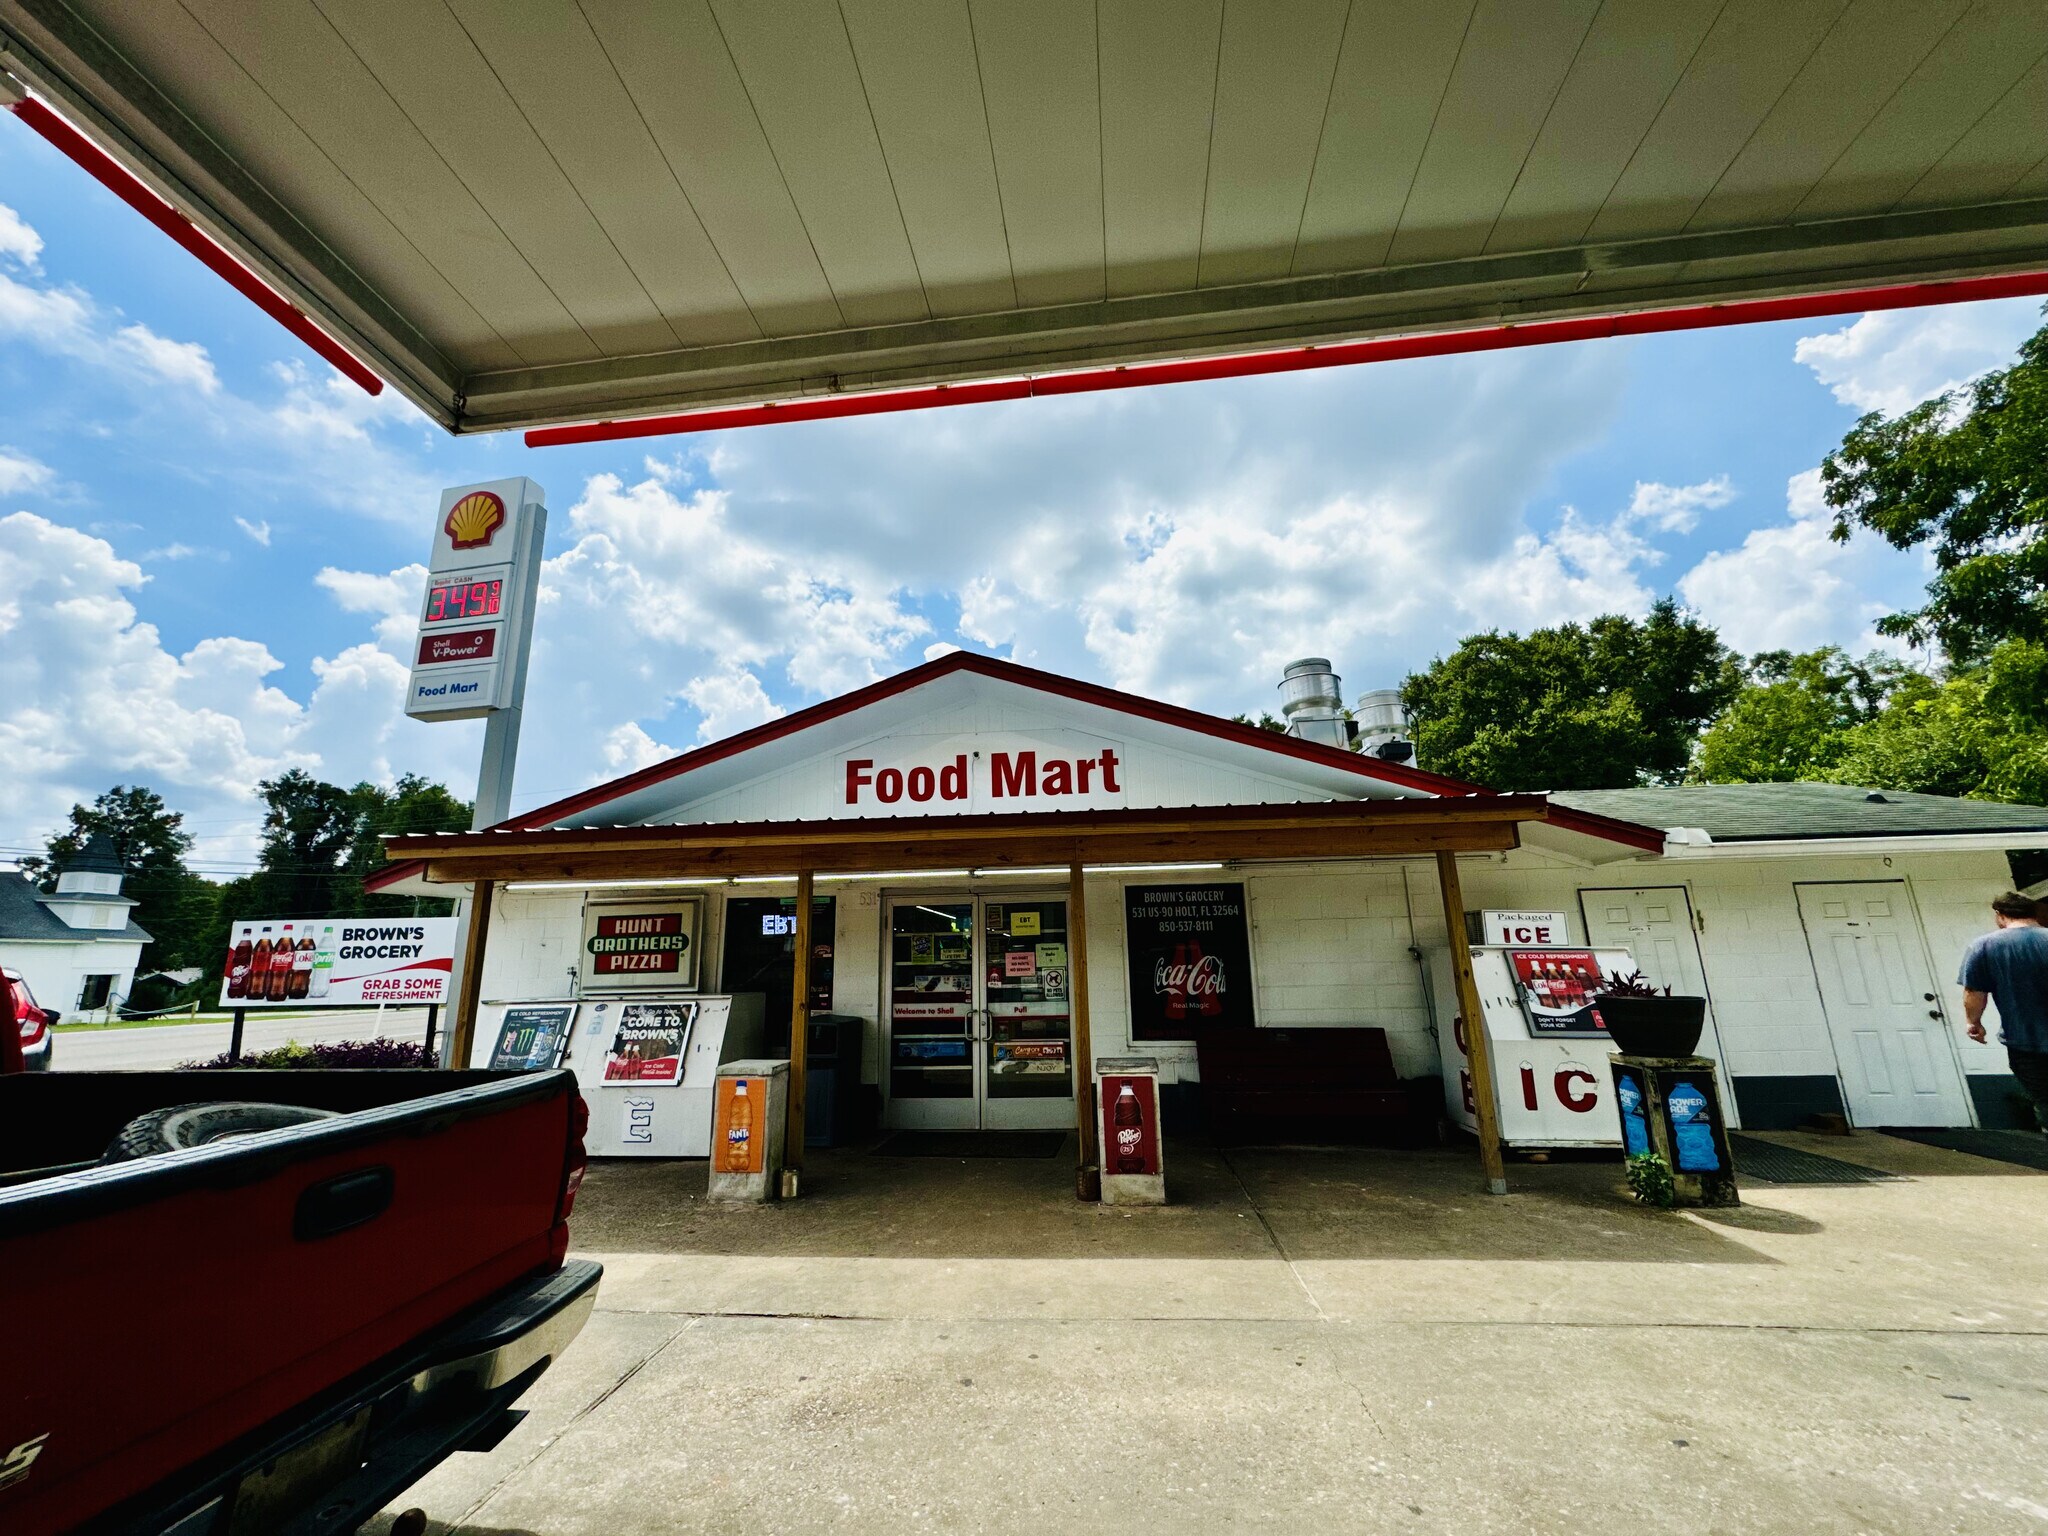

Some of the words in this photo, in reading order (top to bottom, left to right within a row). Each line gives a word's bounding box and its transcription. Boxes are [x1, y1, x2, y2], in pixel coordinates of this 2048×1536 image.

[454, 576, 473, 584] CASH
[433, 640, 450, 648] Shell
[433, 646, 478, 658] V-Power
[418, 684, 447, 697] Food
[449, 682, 478, 694] Mart
[846, 754, 968, 805] Food
[991, 749, 1121, 798] Mart
[1144, 892, 1184, 903] BROWN'S
[1185, 891, 1225, 902] GROCERY
[1132, 907, 1146, 918] 531
[1175, 906, 1199, 917] HOLT,
[1201, 906, 1211, 916] FL
[1213, 905, 1239, 916] 32564
[1497, 914, 1553, 922] Packaged
[615, 918, 665, 934] HUNT
[1159, 921, 1214, 932] 850-537-8111
[342, 927, 424, 942] BROWN'S
[1503, 926, 1551, 943] ICE
[593, 935, 683, 952] BROTHERS
[339, 945, 424, 959] GROCERY
[610, 954, 662, 970] PIZZA
[1154, 955, 1227, 996] Coca-Cola
[363, 979, 401, 990] GRAB
[404, 978, 443, 989] SOME
[361, 990, 442, 1000] REFRESHMENT
[1188, 1002, 1210, 1010] Magic
[627, 1016, 661, 1027] COME
[665, 1016, 680, 1027] TO
[622, 1028, 679, 1040] BROWN'S
[1619, 1088, 1639, 1099] POWER
[1668, 1098, 1703, 1106] POWER
[1120, 1131, 1140, 1144] Pepper
[1125, 1129, 1135, 1137] Dr
